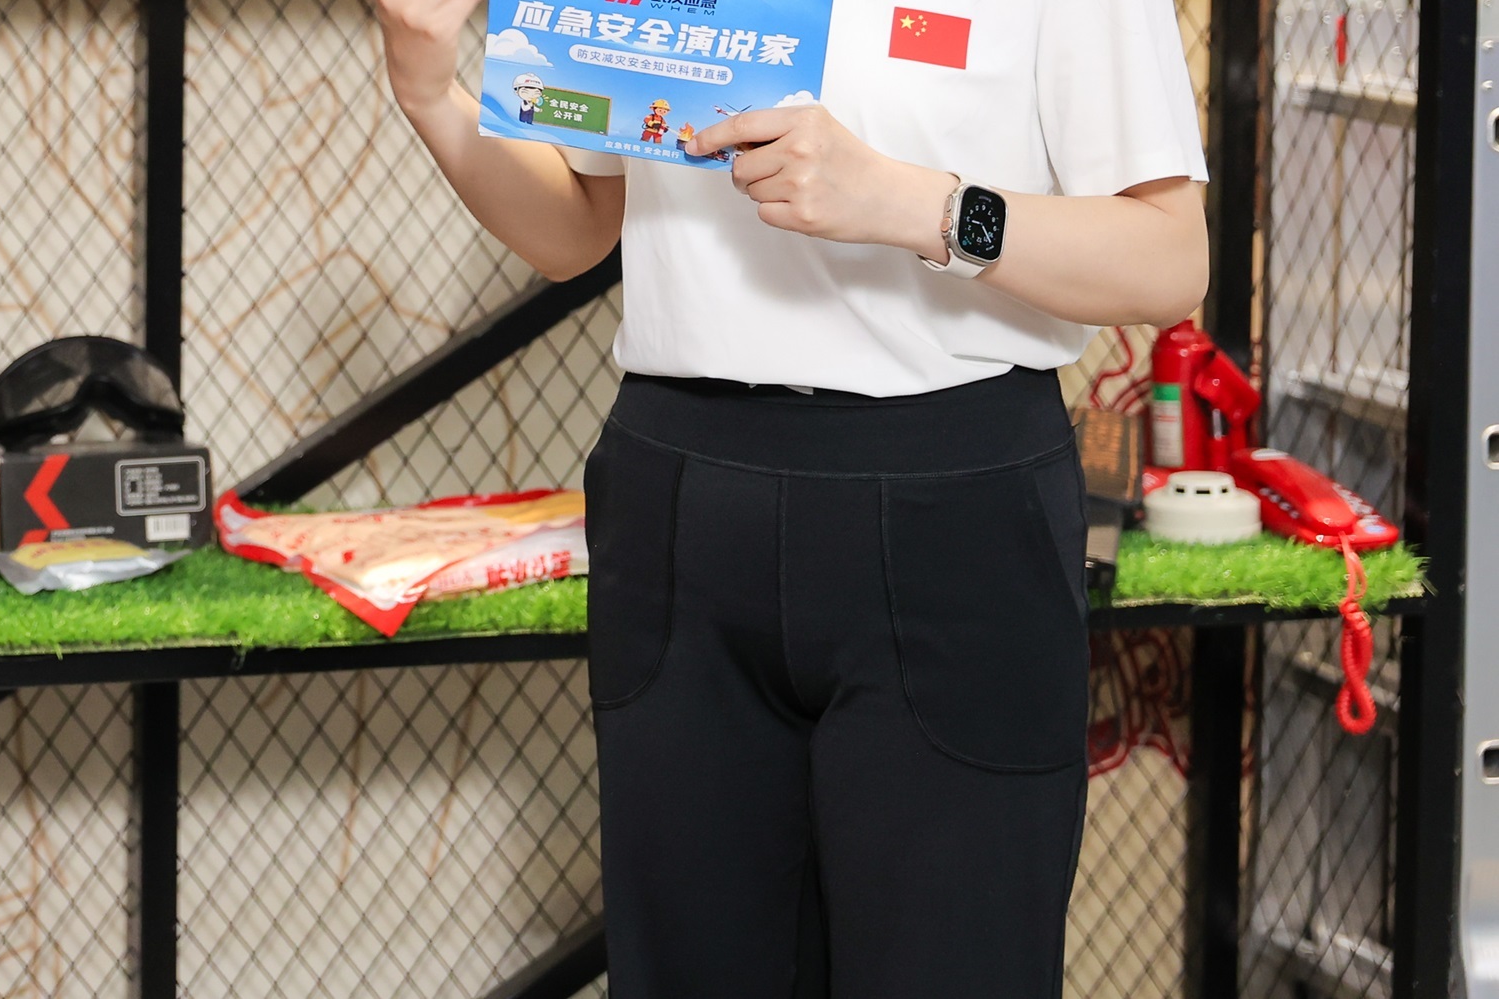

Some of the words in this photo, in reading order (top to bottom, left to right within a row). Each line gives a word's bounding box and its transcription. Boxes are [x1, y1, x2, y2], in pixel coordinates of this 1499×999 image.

[650, 3, 715, 16] WHEM
[511, 0, 800, 67] 应急安全演说家
[576, 48, 729, 82] 防灾减灾安全知识科普直播
[549, 99, 589, 112] 全民安全
[553, 110, 583, 122] 公开课
[644, 146, 679, 159] 安全同行
